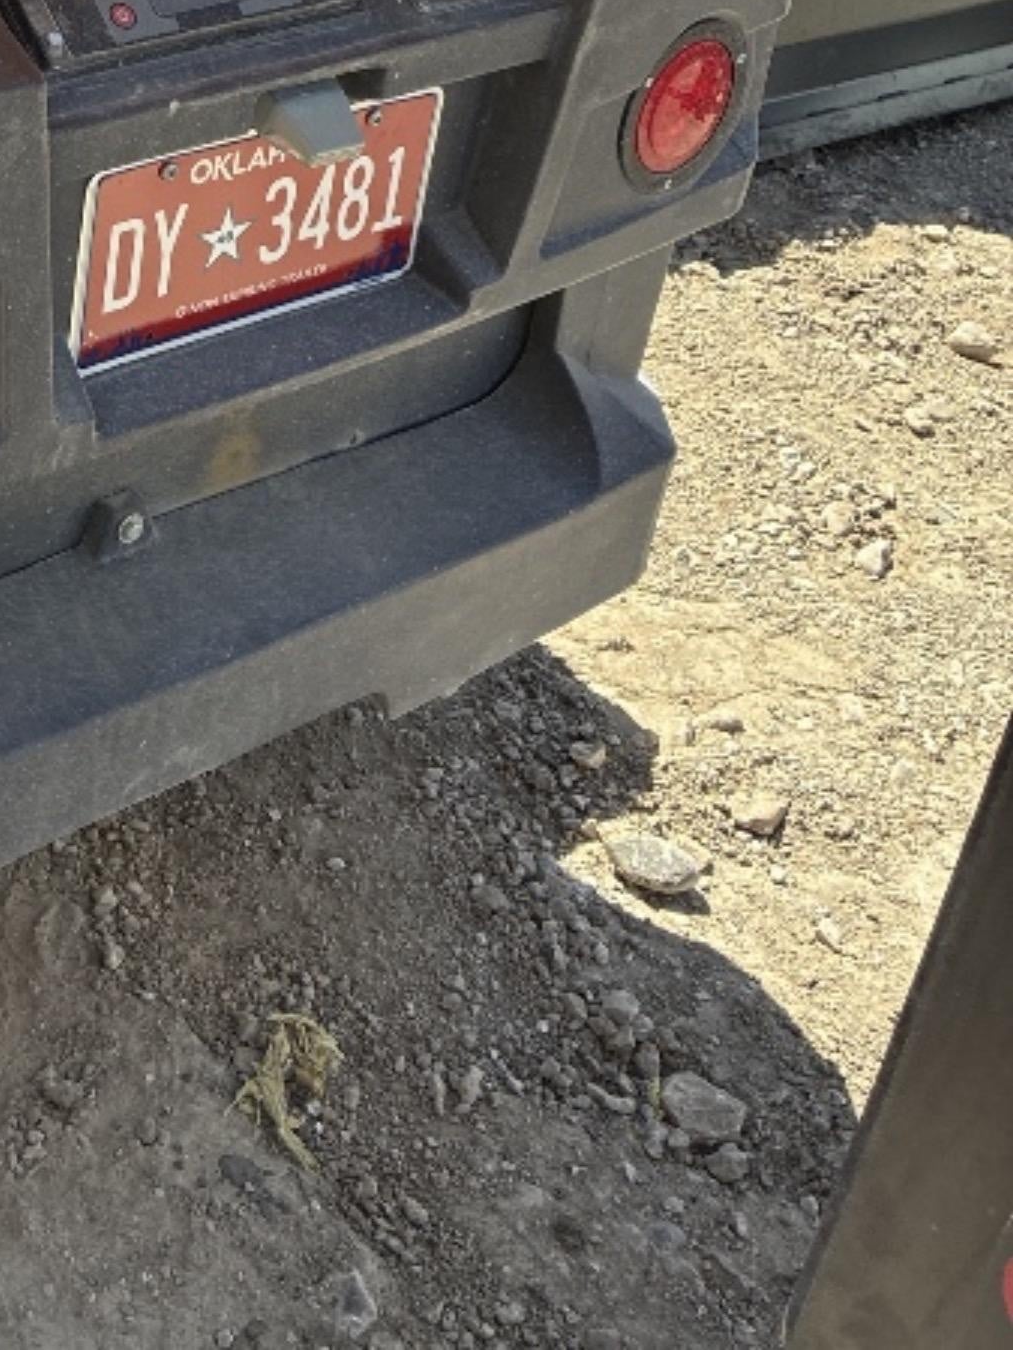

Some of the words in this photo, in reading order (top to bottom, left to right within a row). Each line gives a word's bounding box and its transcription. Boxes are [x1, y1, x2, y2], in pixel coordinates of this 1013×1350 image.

[190, 146, 286, 185] OKLAH
[100, 203, 189, 315] DY
[258, 146, 405, 265] 3481
